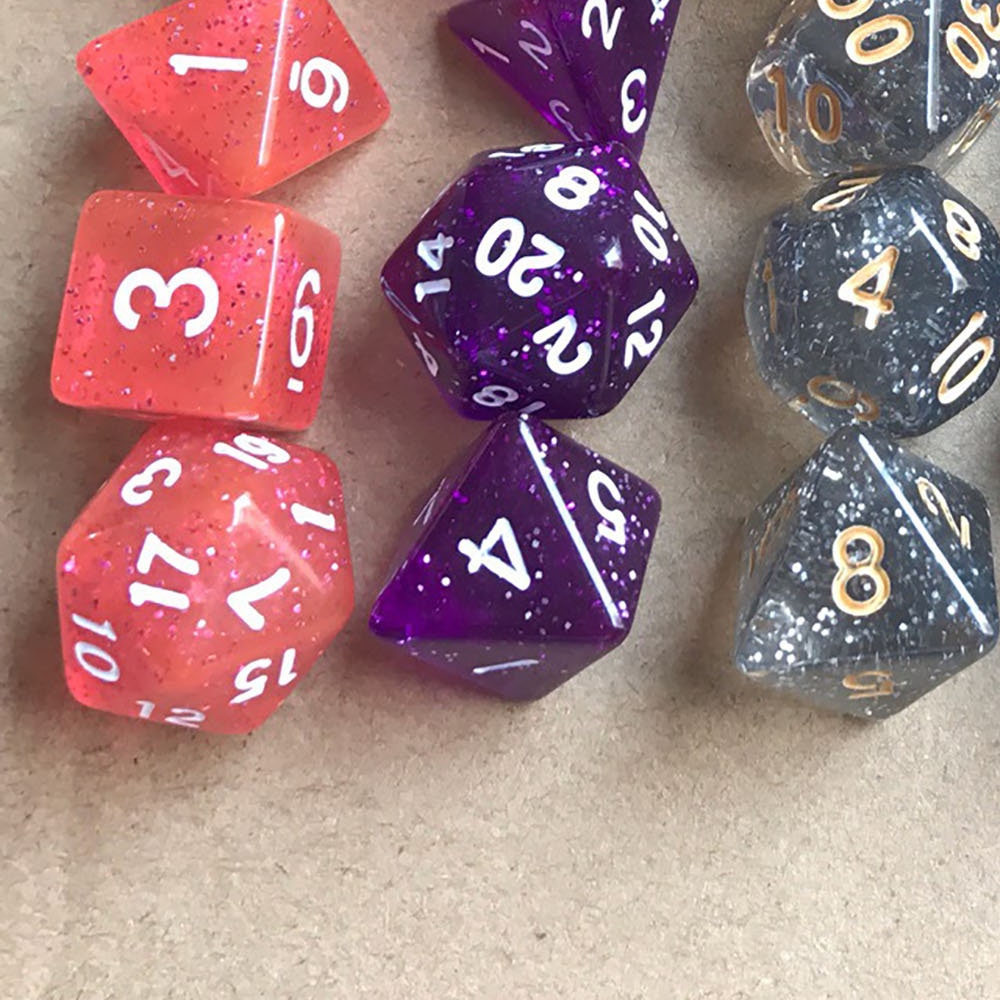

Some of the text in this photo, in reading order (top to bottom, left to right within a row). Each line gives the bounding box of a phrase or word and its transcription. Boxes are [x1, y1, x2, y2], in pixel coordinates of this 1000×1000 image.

[168, 53, 249, 76] 1
[518, 20, 553, 71] 2
[621, 68, 647, 133] 3
[766, 63, 842, 145] 10
[544, 165, 600, 210] 8
[475, 217, 565, 297] 20
[632, 190, 669, 262] 10
[943, 199, 982, 261] 8
[415, 232, 454, 302] 14
[838, 245, 899, 331] 4
[113, 267, 219, 338] 3
[289, 269, 321, 368] 6
[624, 288, 666, 368] 12
[532, 314, 593, 375] 2
[930, 310, 994, 405] 10
[121, 457, 182, 506] 3
[588, 470, 626, 545] 5
[290, 502, 336, 532] 1
[128, 532, 199, 611] 17
[458, 517, 531, 591] 4
[832, 525, 891, 616] 8
[227, 567, 291, 631] 7
[72, 613, 120, 682] 10
[229, 648, 297, 705] 15
